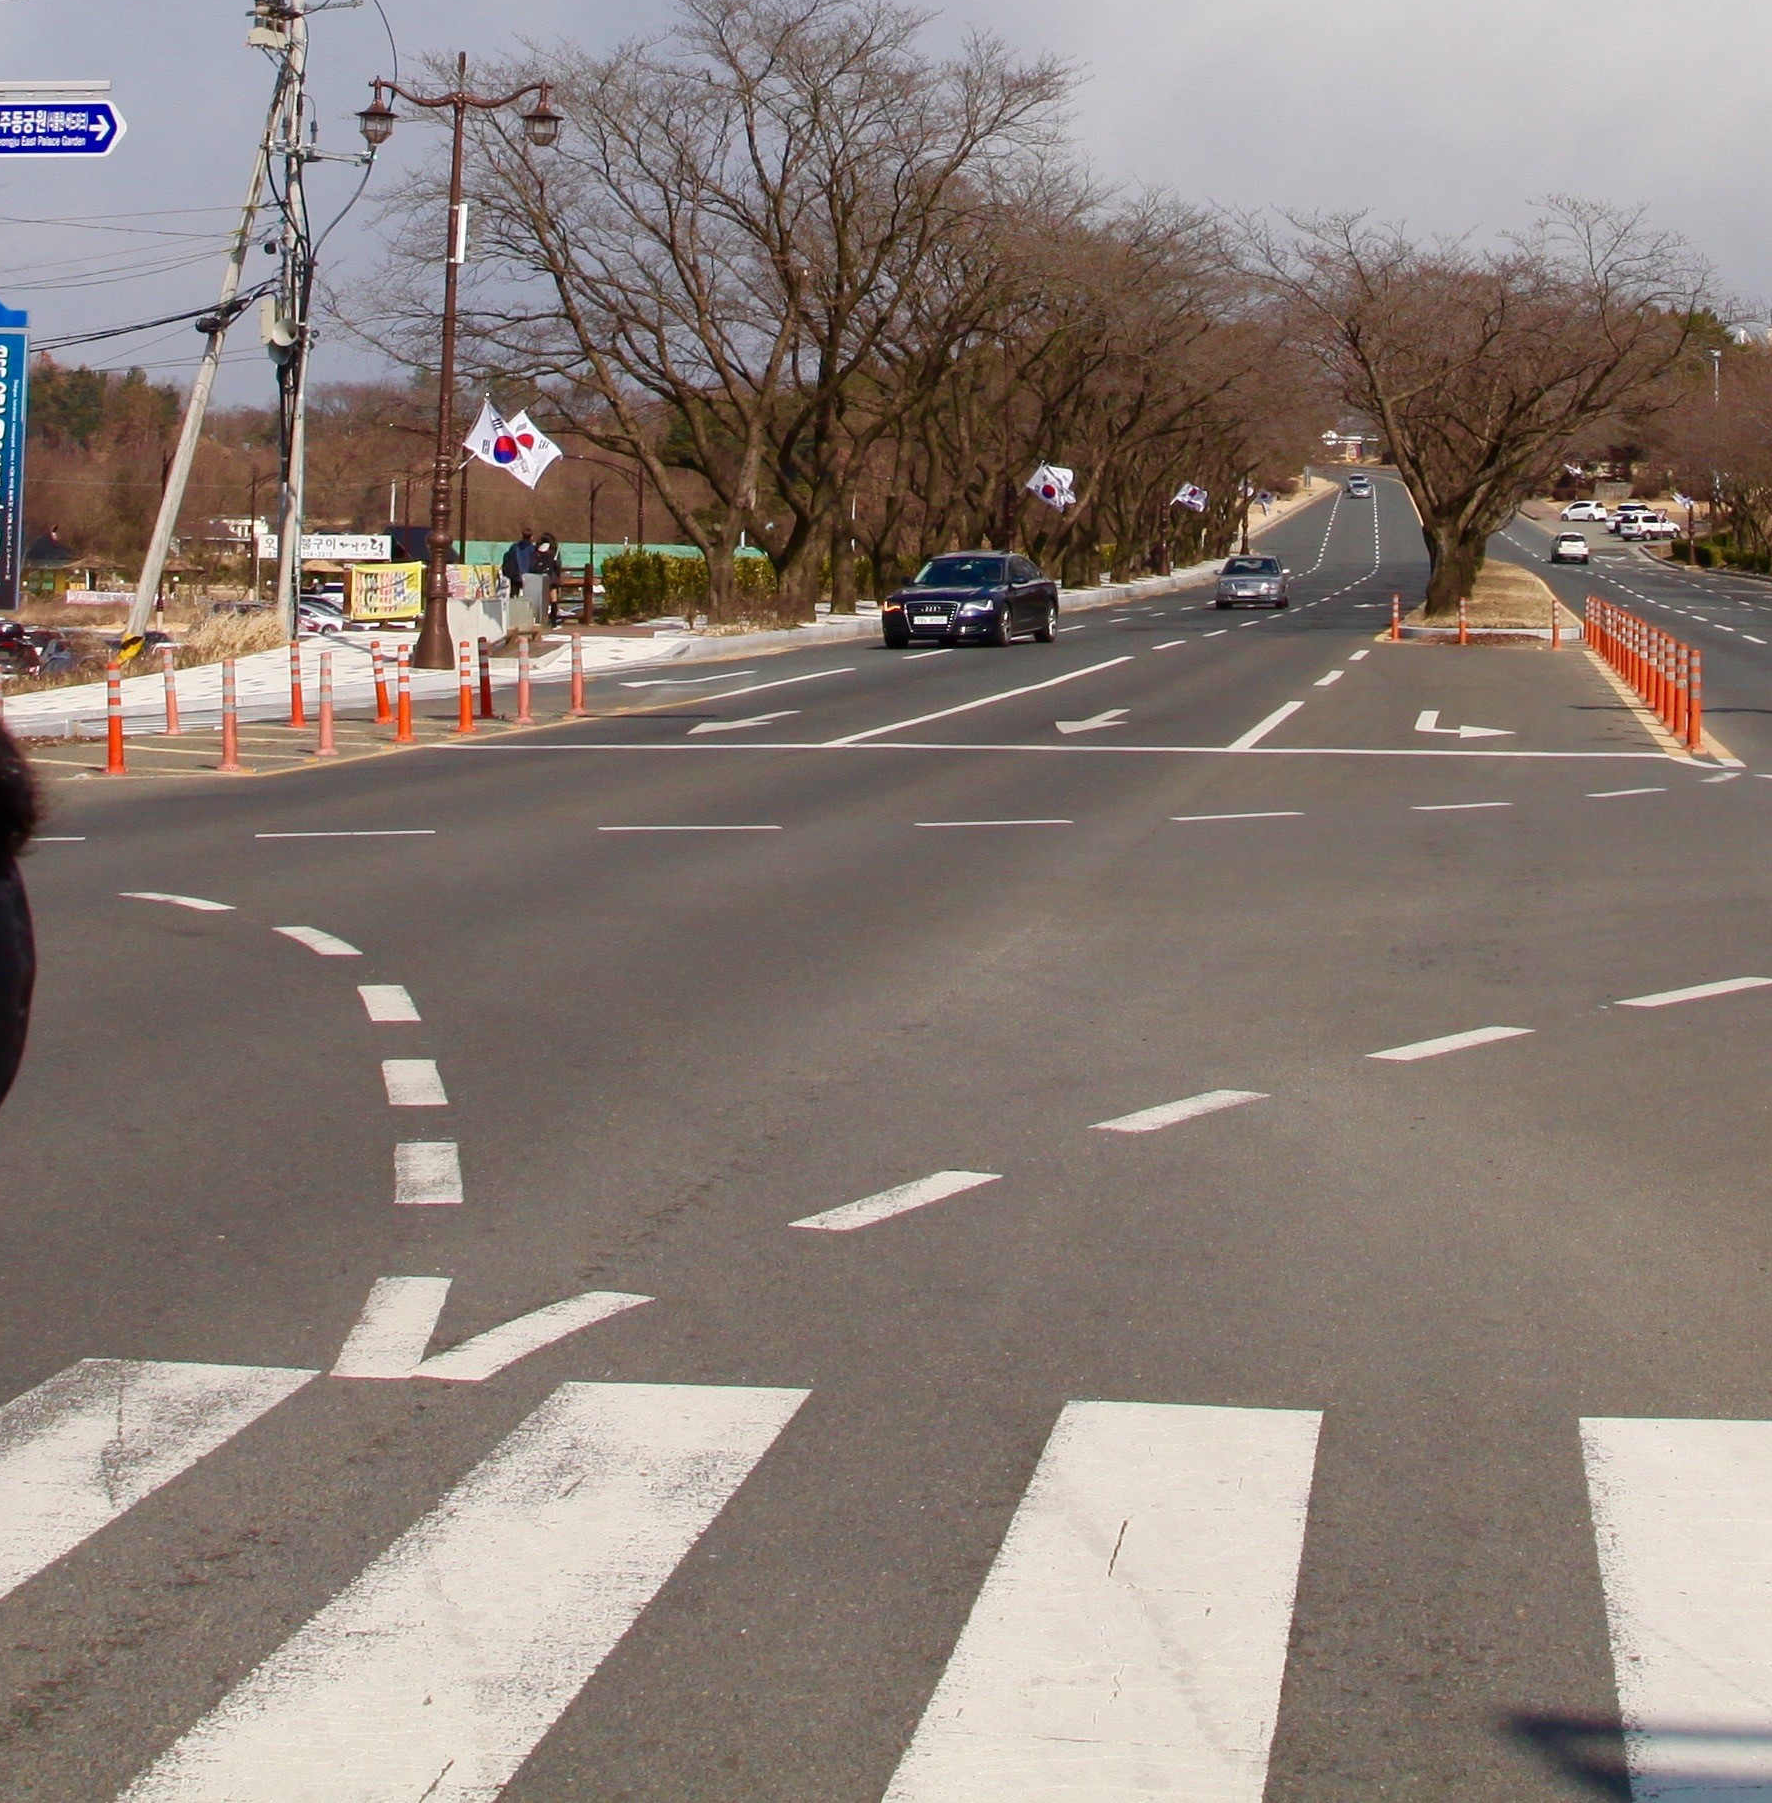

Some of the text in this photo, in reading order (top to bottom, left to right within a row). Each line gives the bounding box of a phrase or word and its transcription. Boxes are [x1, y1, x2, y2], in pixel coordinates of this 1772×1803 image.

[21, 136, 37, 147] East
[38, 136, 61, 147] Palace
[61, 136, 87, 147] Garden
